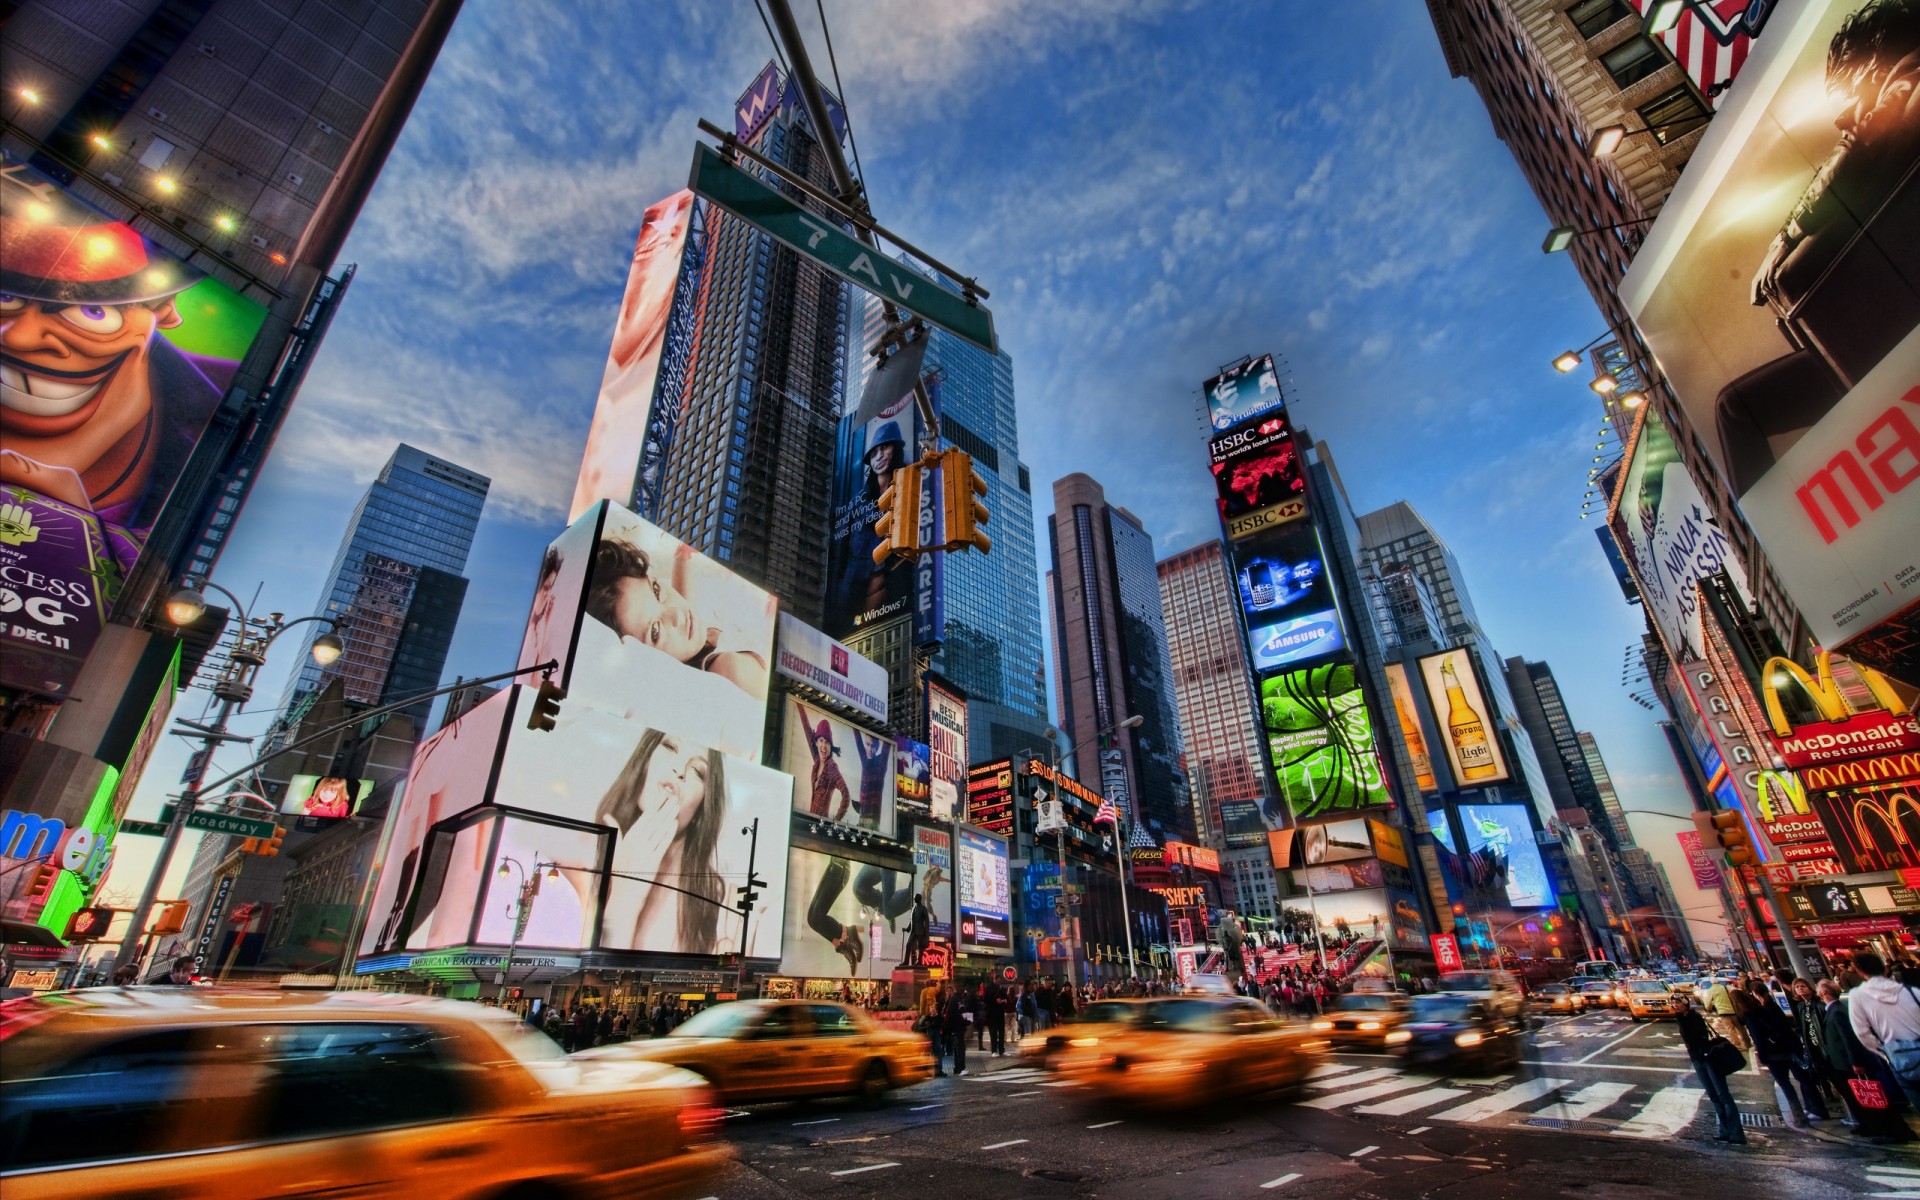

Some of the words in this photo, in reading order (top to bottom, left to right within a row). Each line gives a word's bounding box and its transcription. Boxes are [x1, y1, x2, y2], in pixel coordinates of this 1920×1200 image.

[739, 75, 770, 128] W
[799, 215, 828, 250] 7
[1231, 396, 1281, 422] Prudential
[1211, 428, 1257, 456] HSBC
[1213, 454, 1227, 462] The
[1228, 445, 1252, 458] world's
[1252, 438, 1269, 449] local
[1270, 430, 1288, 441] bank
[848, 500, 854, 509] a
[855, 491, 867, 503] PC
[834, 513, 850, 529] and
[851, 500, 879, 519] Windo
[1230, 509, 1278, 535] HSBC
[834, 528, 849, 540] was
[850, 519, 865, 532] my
[919, 489, 934, 613] SQUARE
[1664, 514, 1701, 585] NINJA
[1894, 565, 1916, 581] DATA
[0, 566, 91, 607] CESS
[863, 599, 901, 622] Windows
[901, 595, 907, 606] 7
[1832, 588, 1879, 621] RECORDABLE
[918, 624, 932, 634] NYC
[1836, 611, 1861, 628] MEDIA
[11, 624, 52, 645] DEC.
[54, 635, 70, 650] 11
[1268, 627, 1326, 651] SAMSUNG
[834, 653, 846, 669] GAP
[781, 650, 813, 679] READY
[812, 665, 830, 687] FOR
[829, 674, 864, 704] HOLIDAY
[864, 693, 886, 716] CHEER
[932, 709, 964, 736] MUSICAL
[939, 702, 957, 721] BEST
[932, 723, 954, 758] BILLY
[1270, 734, 1294, 746] display
[1295, 728, 1327, 740] powered
[1451, 726, 1483, 738] Corona
[1782, 719, 1920, 754] McDonald's
[1274, 745, 1283, 753] by
[1284, 742, 1300, 750] wind
[1301, 737, 1327, 747] energy
[1461, 745, 1487, 760] Light
[1810, 738, 1904, 761] Restaurant
[990, 760, 1010, 771] REUTERS
[192, 815, 259, 835] roadway
[1768, 820, 1823, 835] McDon
[1784, 830, 1825, 840] Restaur
[919, 828, 949, 849] HEIGHTS
[1131, 848, 1163, 859] Reese's
[1785, 848, 1811, 857] OPEN
[411, 957, 449, 967] AMERICAN
[452, 956, 487, 966] EAGLE
[922, 951, 945, 966] ROXY
[1086, 941, 1123, 964] 1585
[1438, 937, 1455, 965] tkts
[1005, 969, 1015, 978] W
[1181, 953, 1193, 979] tkts
